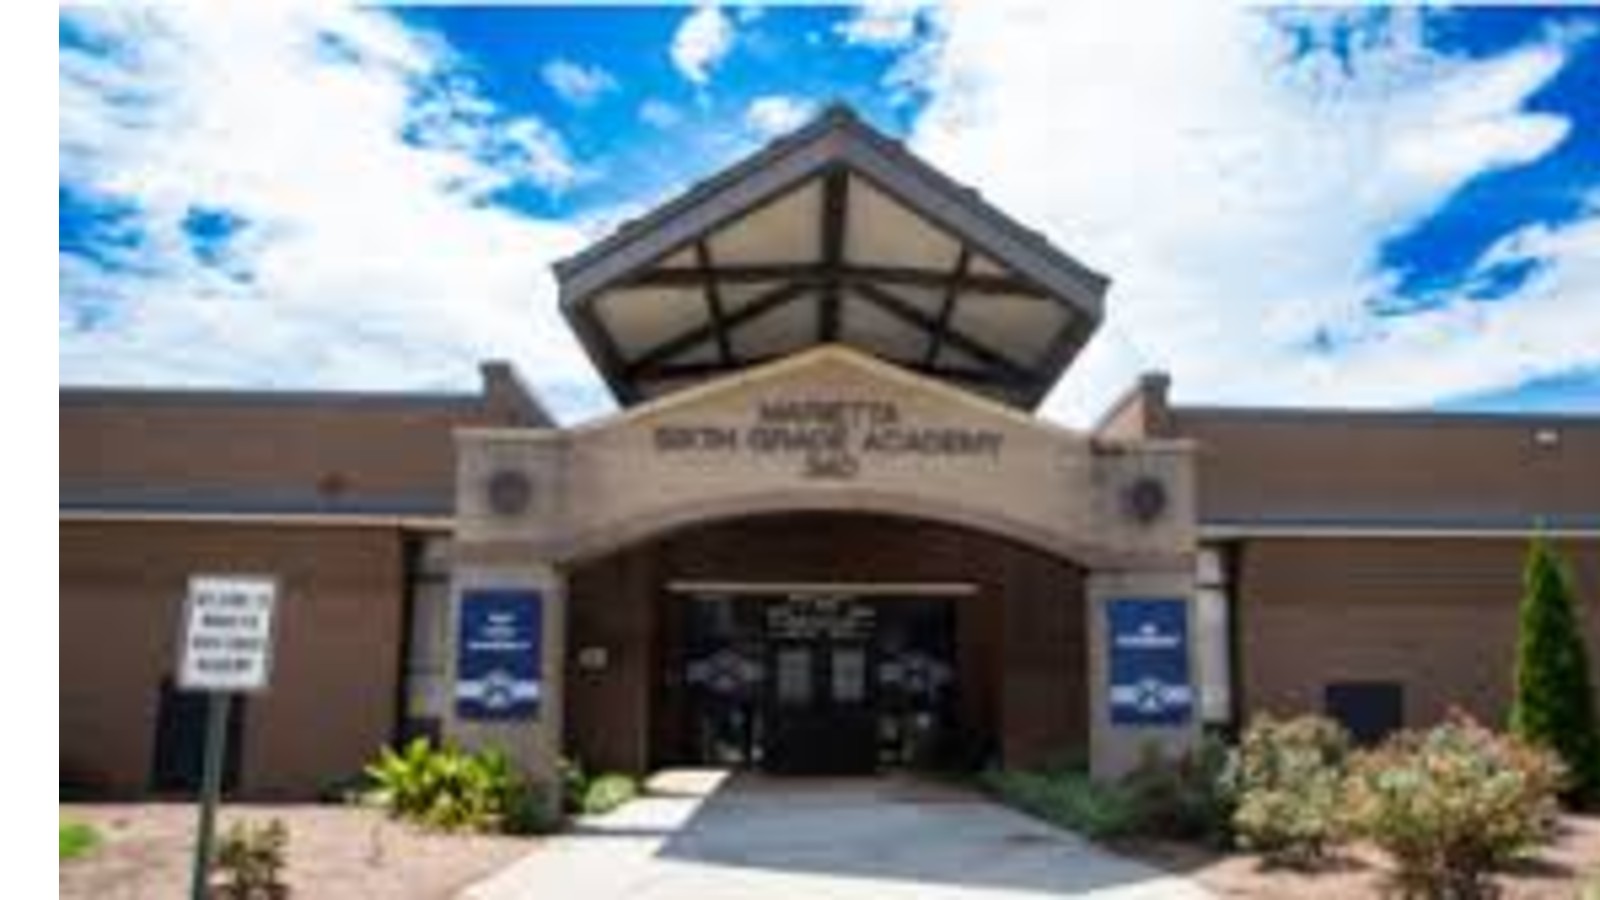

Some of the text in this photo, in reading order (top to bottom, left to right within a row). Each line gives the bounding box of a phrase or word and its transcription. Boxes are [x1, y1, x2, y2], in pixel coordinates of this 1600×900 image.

[757, 400, 898, 426] MARIETTA
[748, 427, 850, 453] GRADE
[862, 429, 1004, 456] ACADEMY
